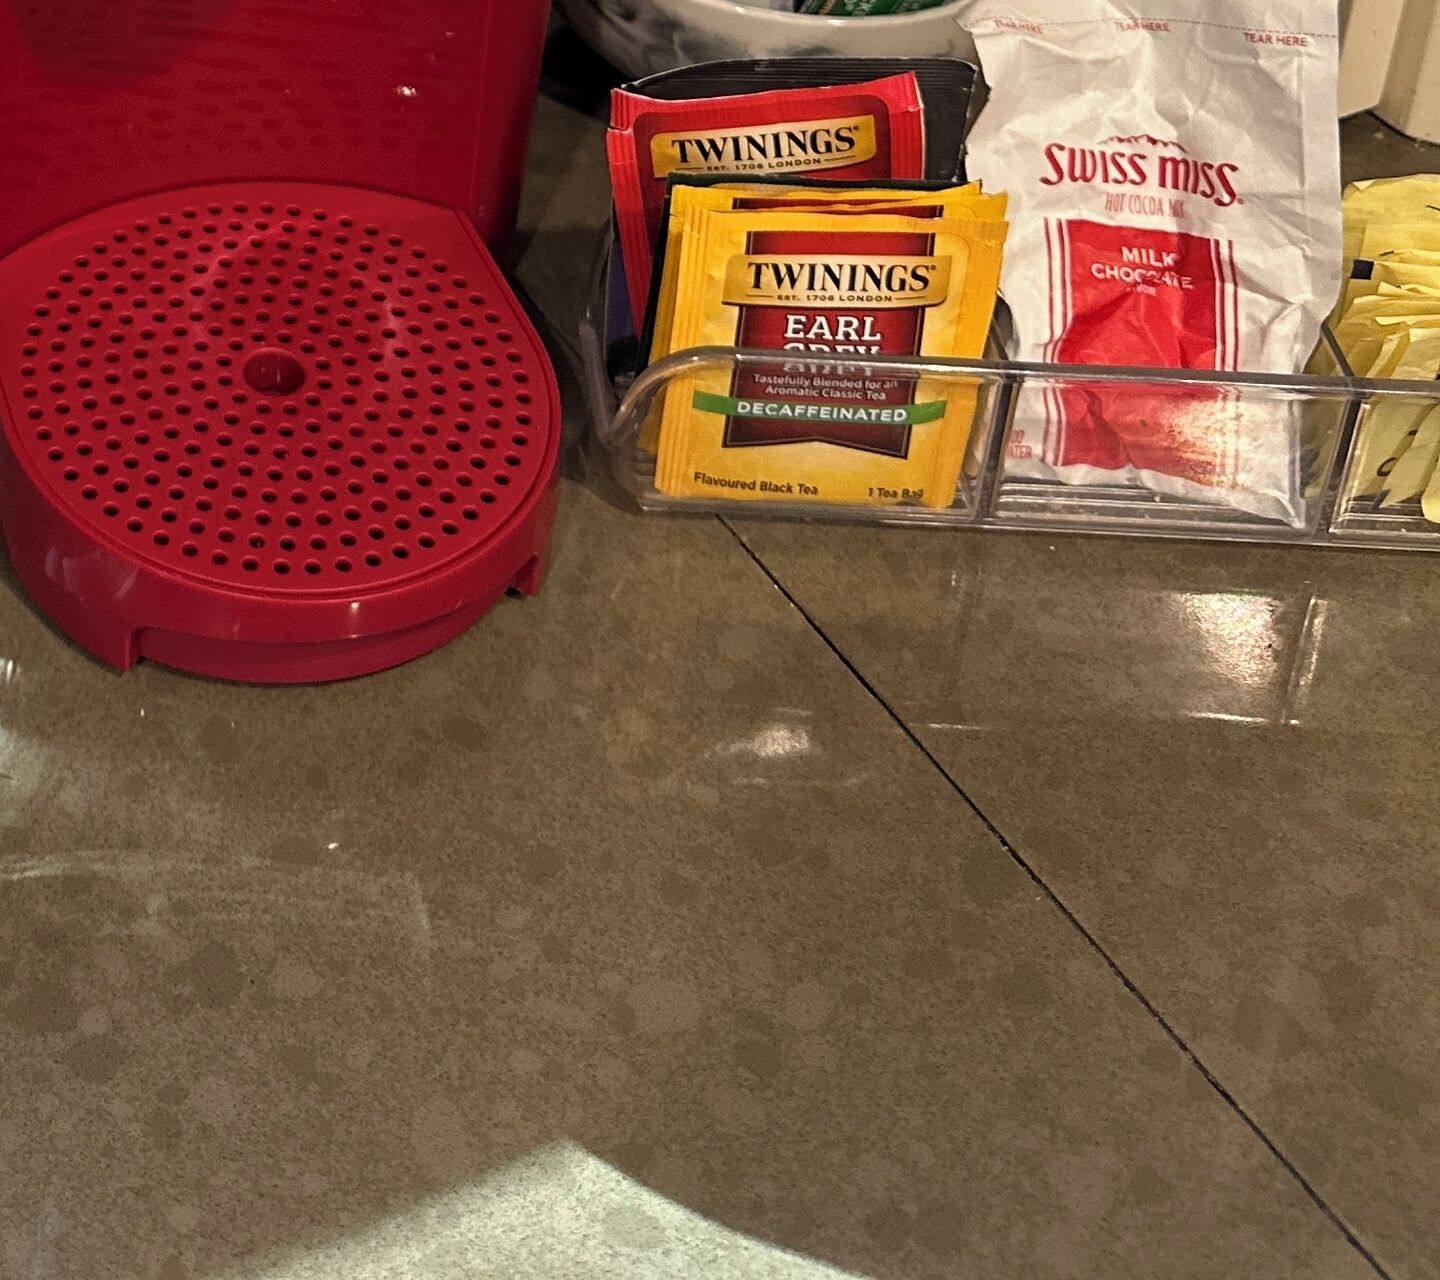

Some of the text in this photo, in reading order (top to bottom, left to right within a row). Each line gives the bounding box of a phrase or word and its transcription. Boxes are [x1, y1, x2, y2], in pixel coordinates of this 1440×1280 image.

[1141, 21, 1171, 32] HERE
[1243, 32, 1308, 47] TEAR HERE
[671, 125, 856, 164] TWININGS
[735, 162, 764, 171] 1706
[768, 157, 822, 169] LONDON
[1038, 142, 1148, 186] SWISS
[1105, 192, 1126, 212] HOT
[1128, 194, 1164, 216] COCOA
[1120, 245, 1177, 268] MILK
[747, 261, 931, 293] TWININGS
[806, 294, 835, 302] 1706
[839, 294, 893, 303] LONDON
[783, 313, 882, 341] EARL
[753, 373, 898, 389] Tastefully Blended for an
[764, 385, 887, 401] Aromatic Classic Tea
[737, 401, 908, 423] DECAFFEINATED
[693, 471, 819, 496] Flavoured Black Tea
[867, 487, 873, 498] 1
[875, 487, 898, 499] Tea
